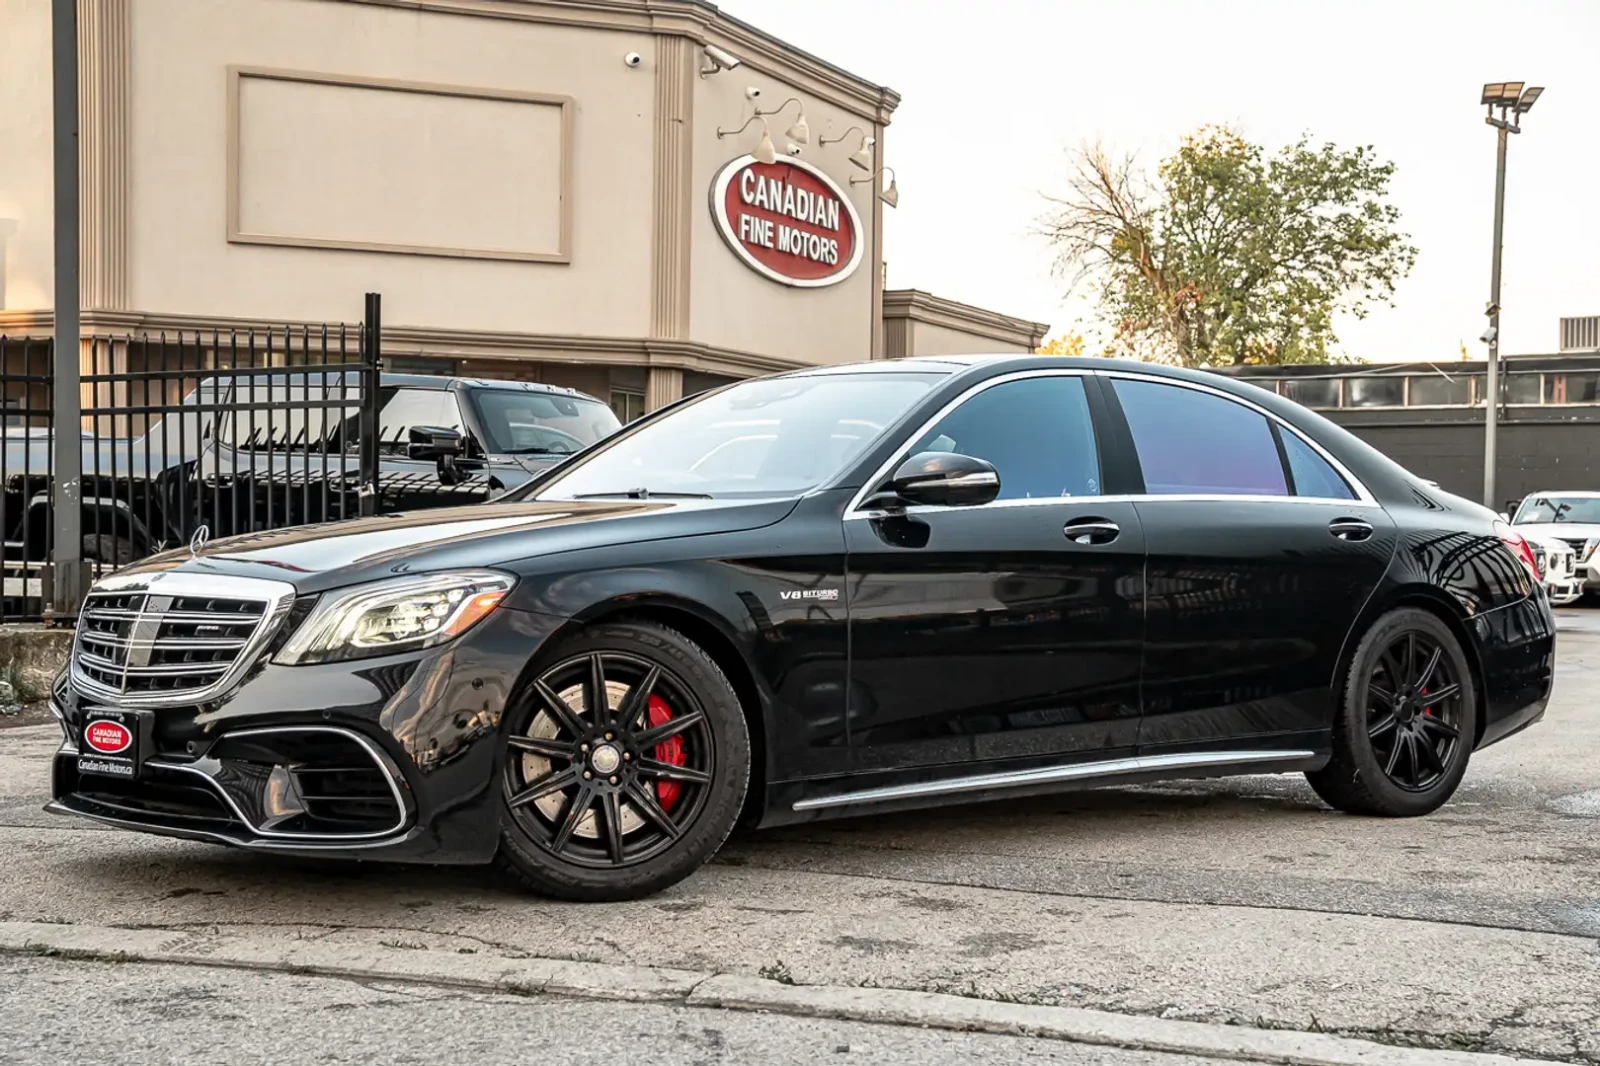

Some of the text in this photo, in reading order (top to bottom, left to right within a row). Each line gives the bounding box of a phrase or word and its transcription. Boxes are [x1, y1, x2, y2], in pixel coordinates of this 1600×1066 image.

[741, 168, 839, 231] CANADIAN
[740, 213, 838, 266] FINE MOTORS
[780, 590, 802, 600] V8
[92, 727, 122, 738] CANADIAN
